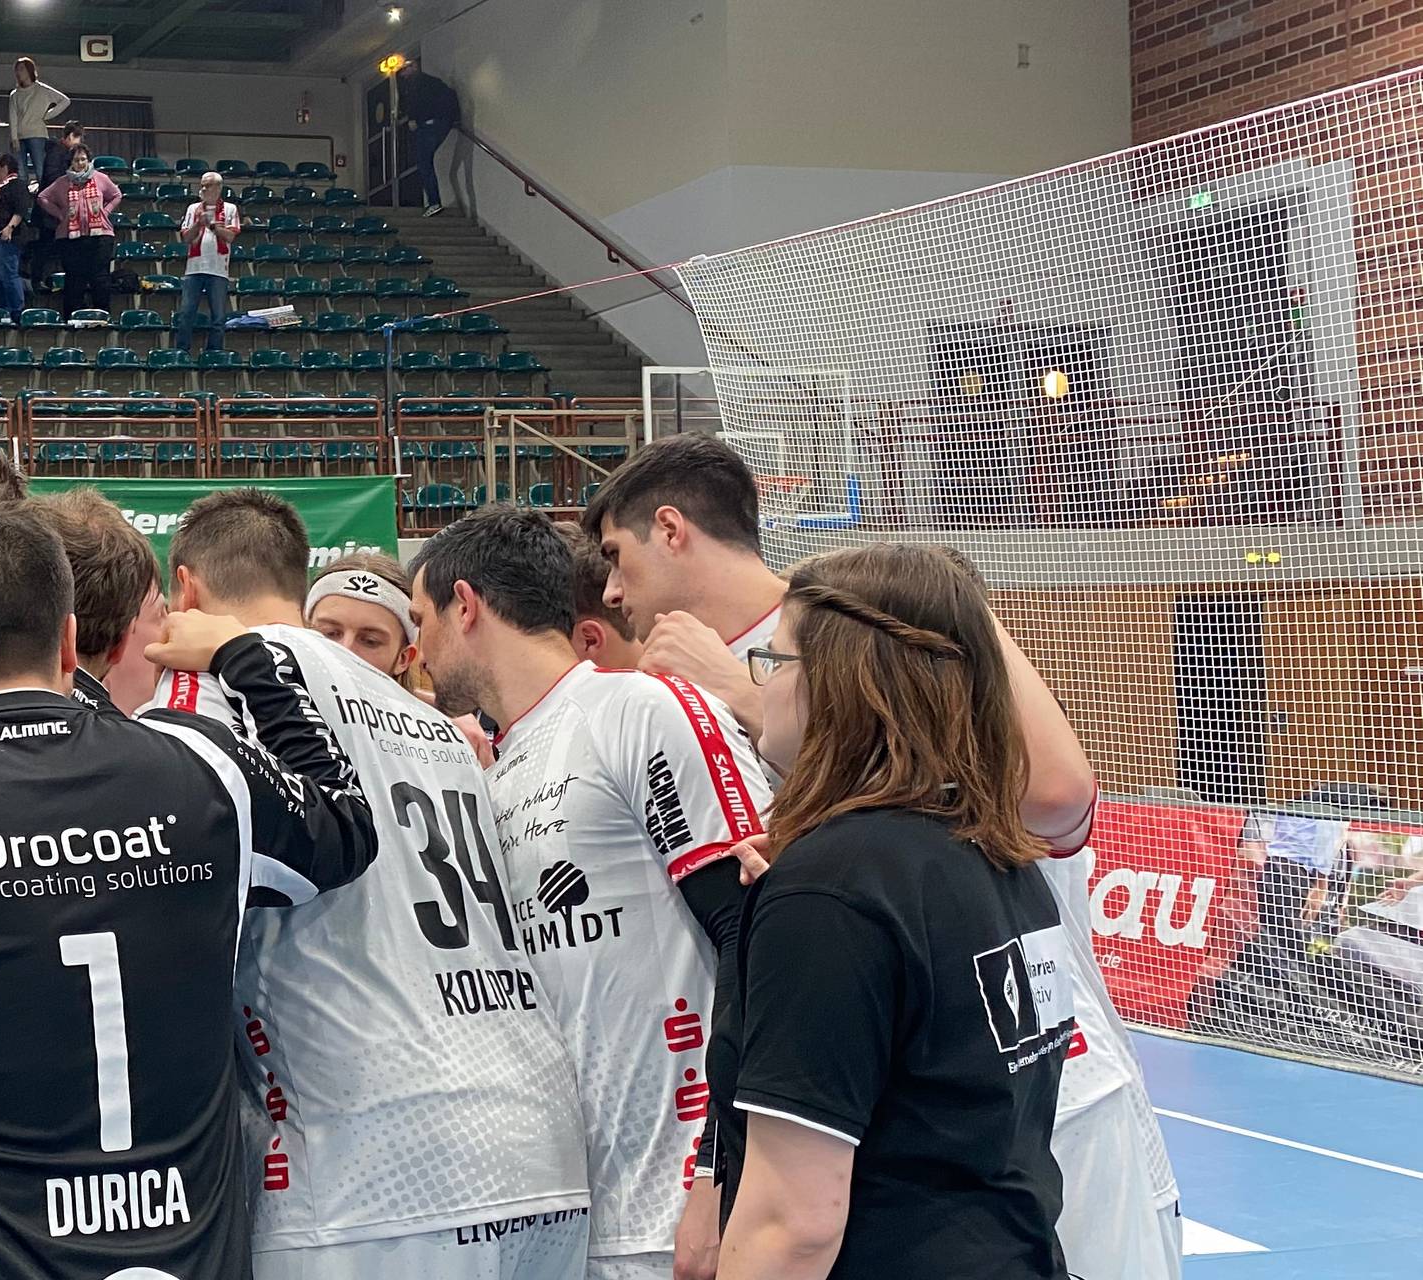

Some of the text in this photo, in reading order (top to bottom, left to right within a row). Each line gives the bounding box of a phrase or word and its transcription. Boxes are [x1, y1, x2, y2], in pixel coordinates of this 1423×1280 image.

[87, 40, 108, 57] C
[379, 738, 474, 765] coating soluti
[524, 819, 570, 841] Herz
[0, 860, 214, 898] coating solutions
[390, 781, 518, 951] 34
[59, 932, 132, 1152] 1
[45, 1166, 191, 1238] DURICA
